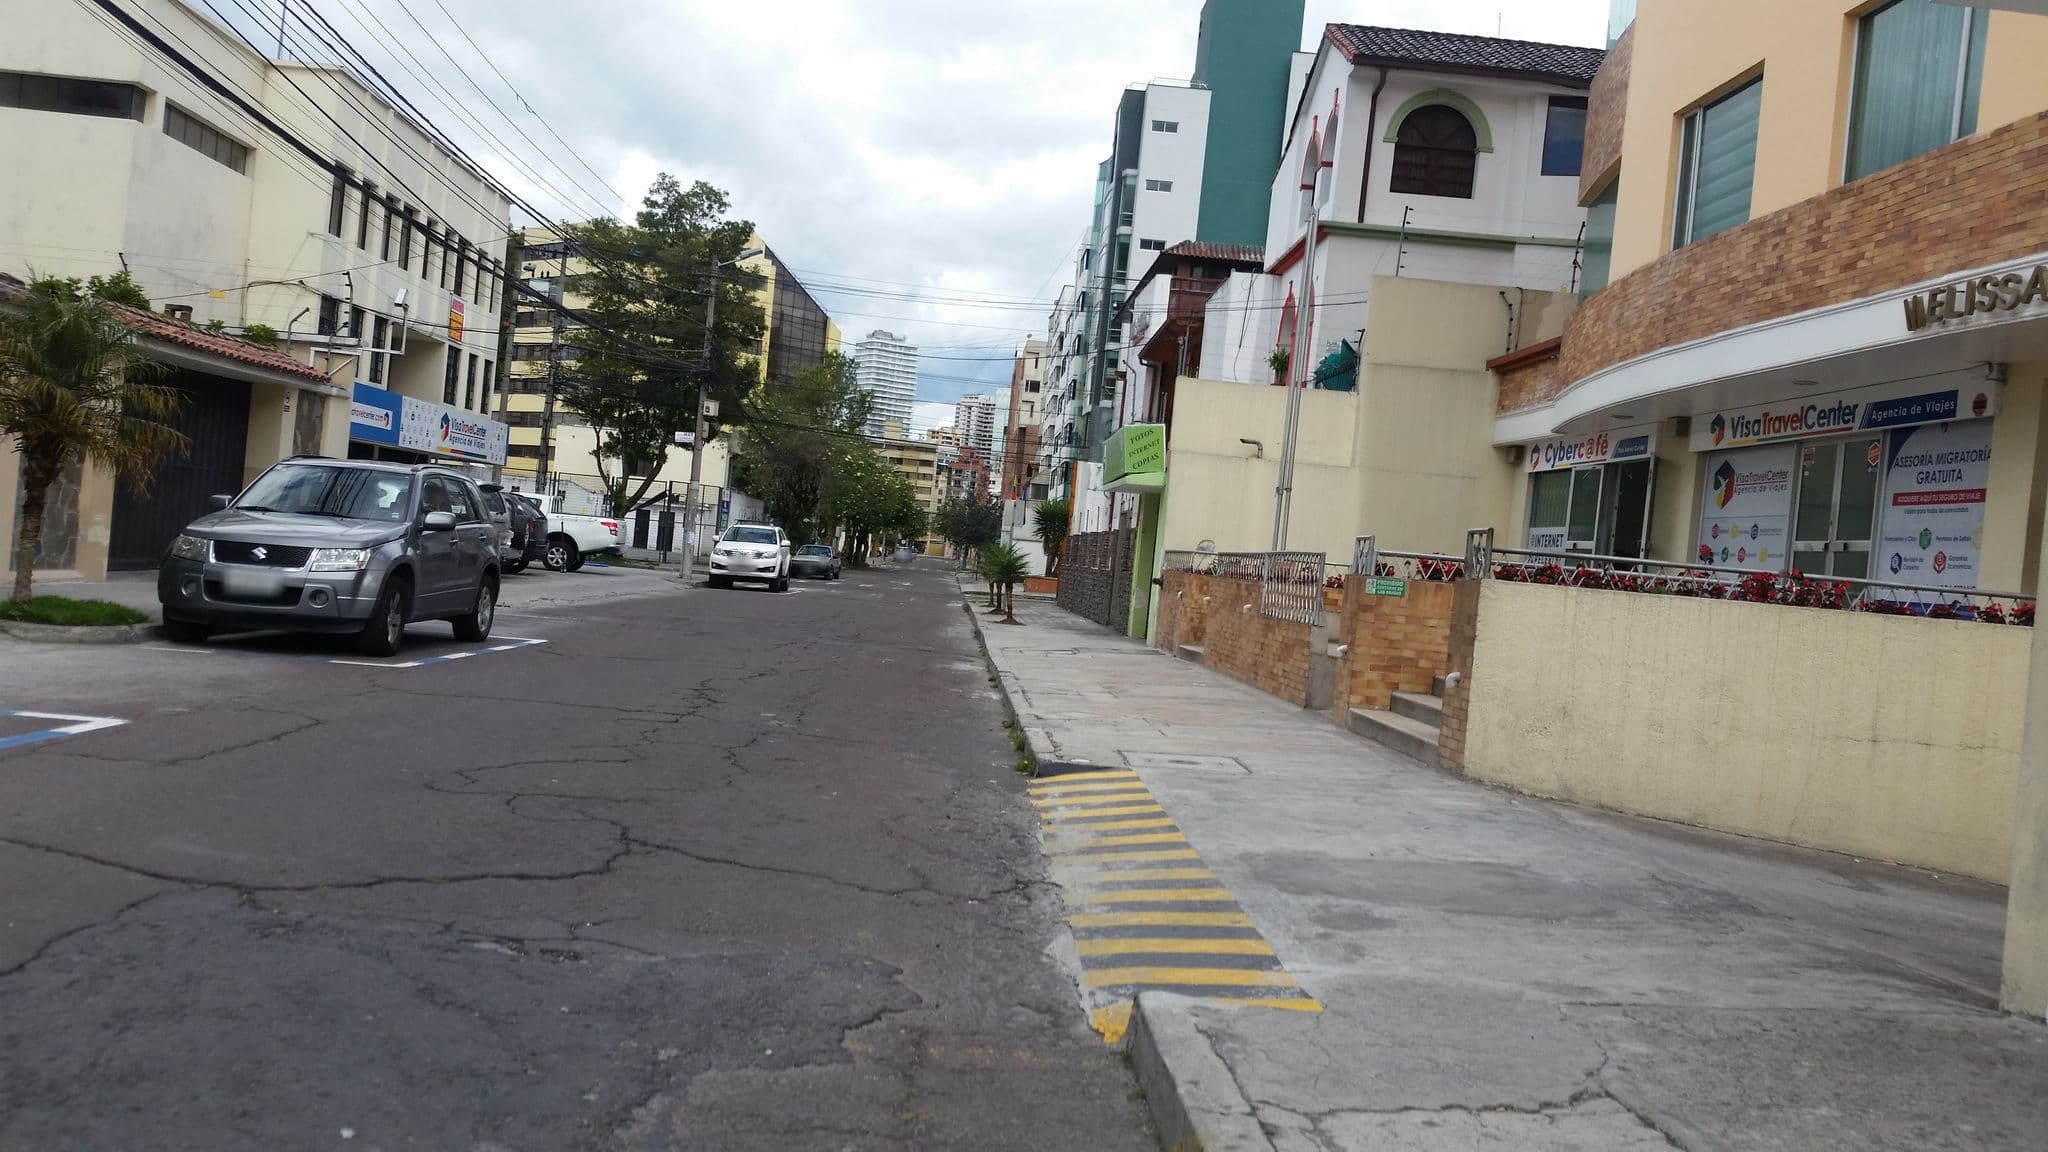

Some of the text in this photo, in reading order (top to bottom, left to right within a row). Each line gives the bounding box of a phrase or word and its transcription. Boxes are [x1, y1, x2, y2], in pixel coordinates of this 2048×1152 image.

[1903, 265, 2048, 332] MELISSA
[1730, 400, 1955, 439] VisaTravelCenter Agencia de Viajes
[1130, 428, 1154, 444] FOTOS
[1128, 438, 1160, 458] INTERNET
[1132, 452, 1159, 470] COPIAS
[1893, 450, 1934, 469] ASESORÍA
[1916, 468, 1963, 485] GRATUITA
